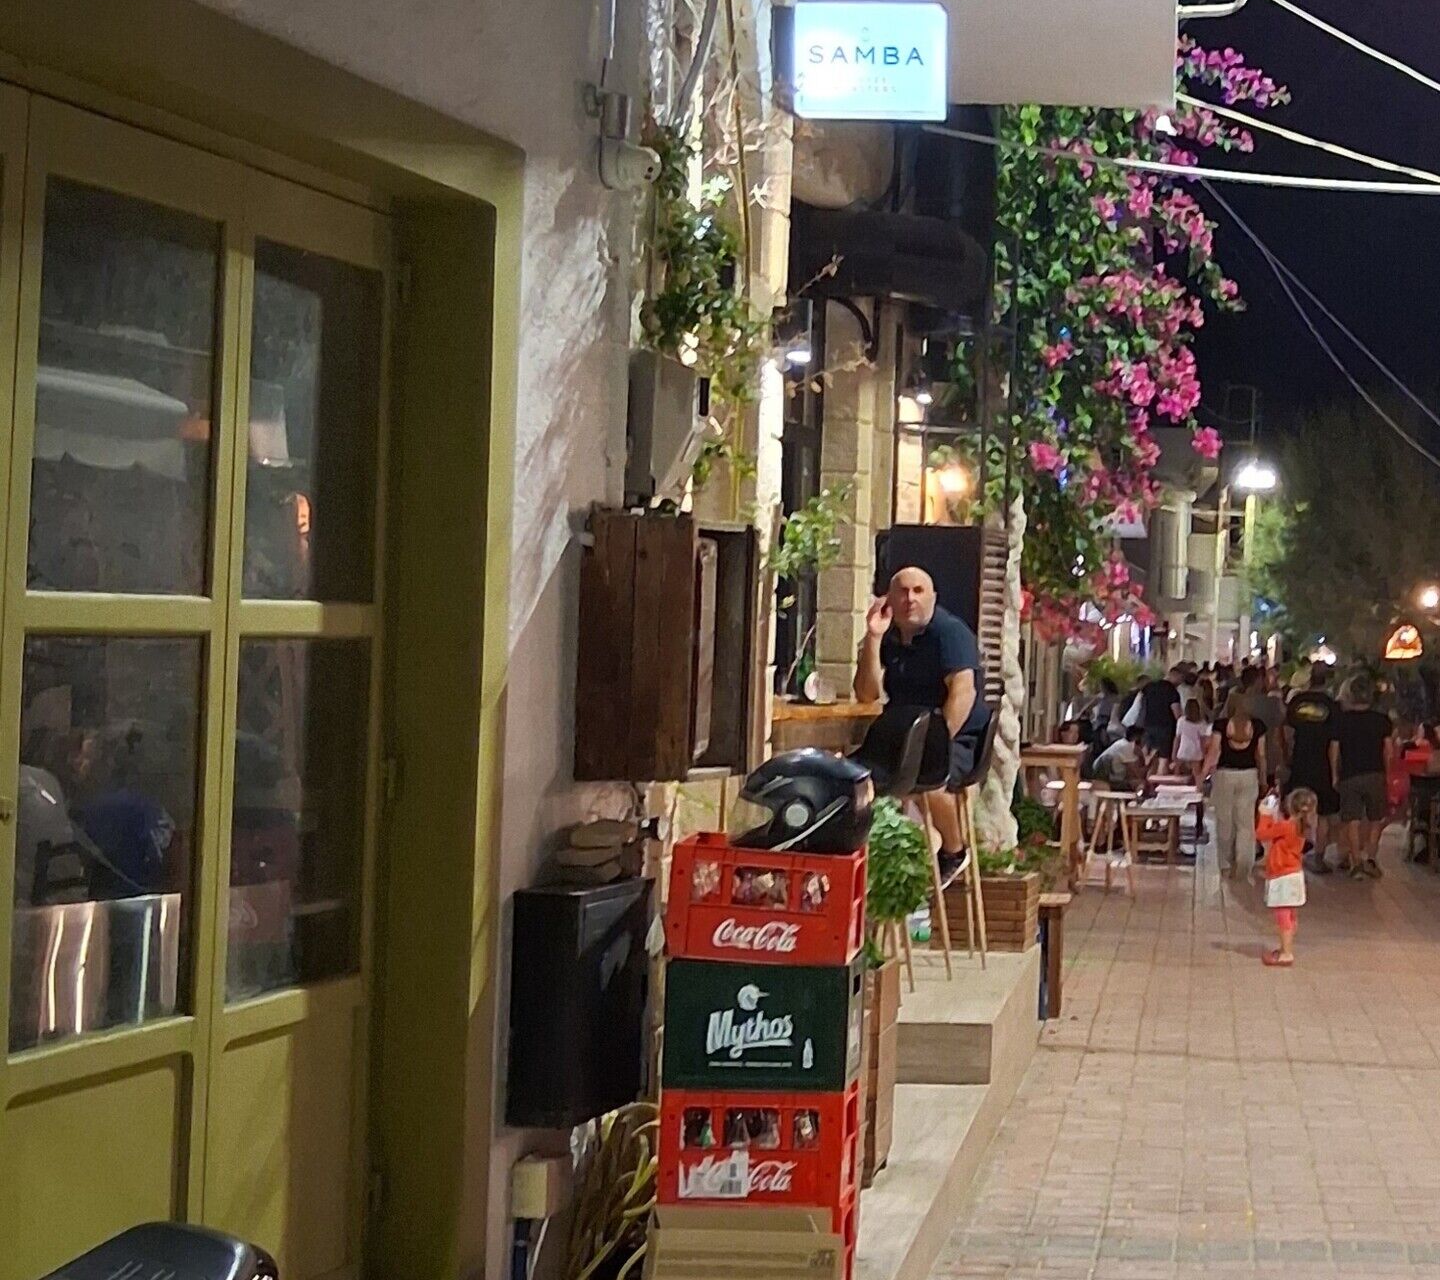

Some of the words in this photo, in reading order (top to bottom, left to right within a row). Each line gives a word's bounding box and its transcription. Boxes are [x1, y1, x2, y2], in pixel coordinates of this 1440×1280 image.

[808, 44, 925, 67] SAMBA
[712, 918, 802, 953] Coca-Cola
[706, 1009, 794, 1059] Mythos
